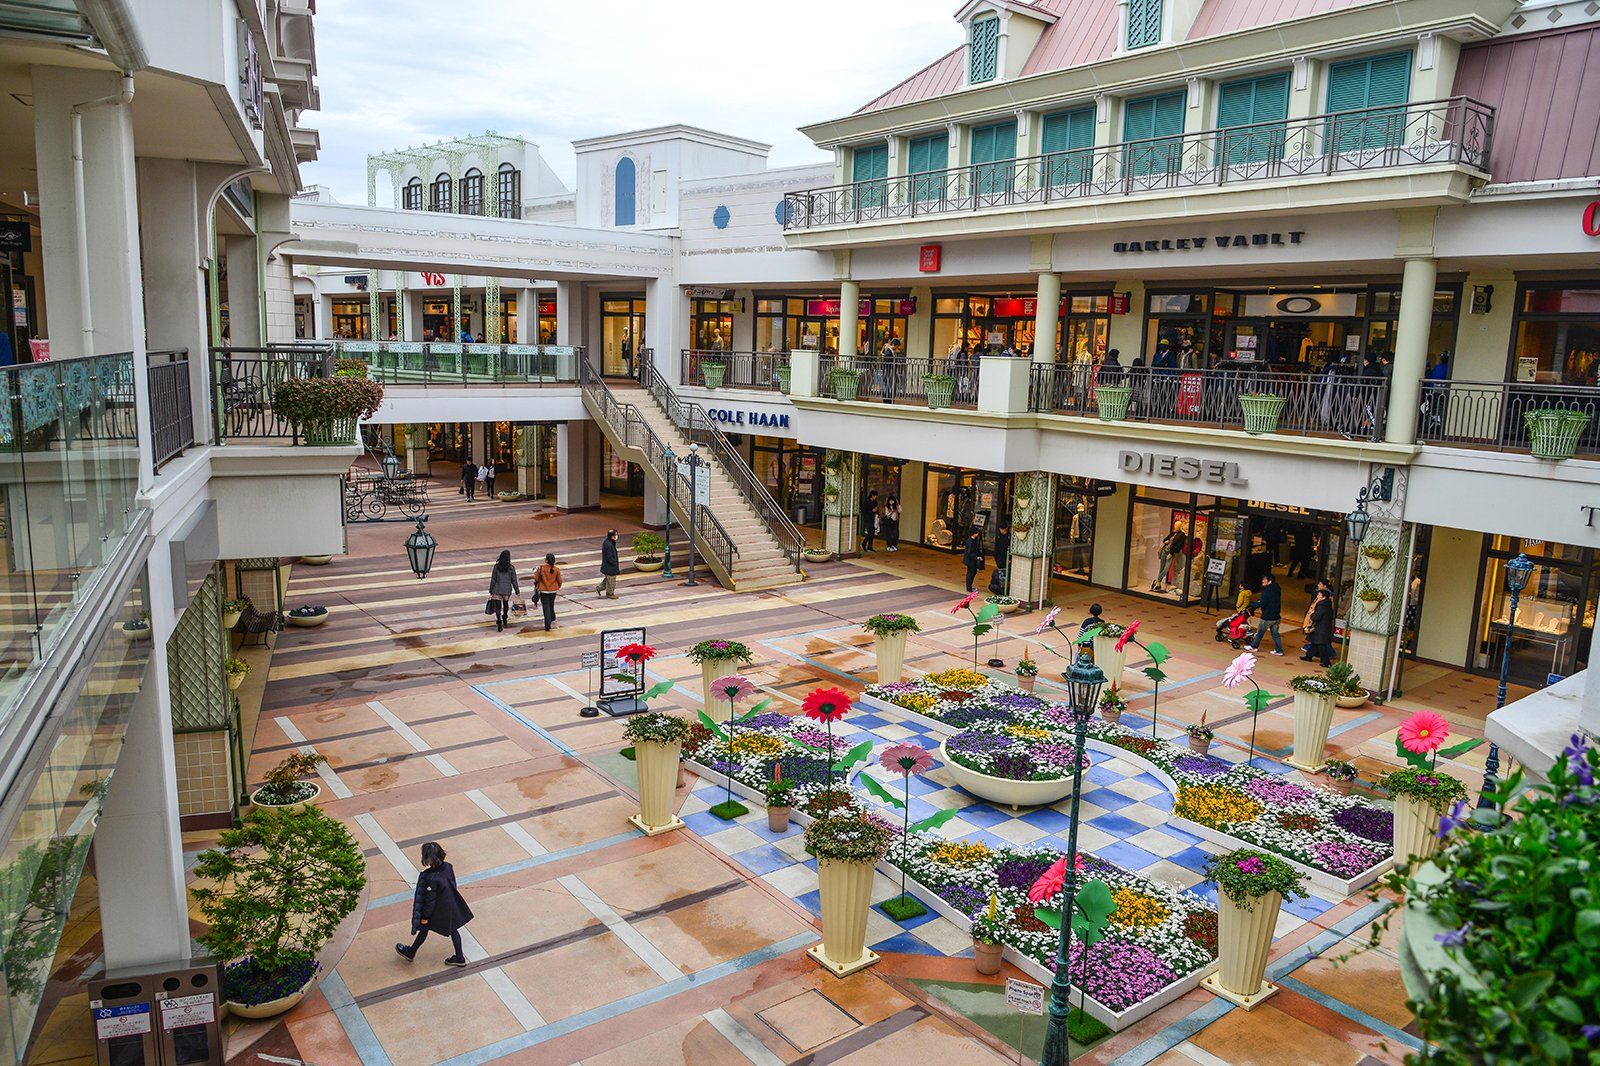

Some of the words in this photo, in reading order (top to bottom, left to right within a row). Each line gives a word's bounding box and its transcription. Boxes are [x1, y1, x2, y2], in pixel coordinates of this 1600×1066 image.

[1113, 237, 1207, 253] OAKLEY
[1215, 231, 1305, 248] VAULT
[708, 408, 744, 424] COLE
[749, 412, 790, 428] HAAN
[1118, 450, 1249, 485] DIESEL
[1247, 500, 1310, 515] DIESEL
